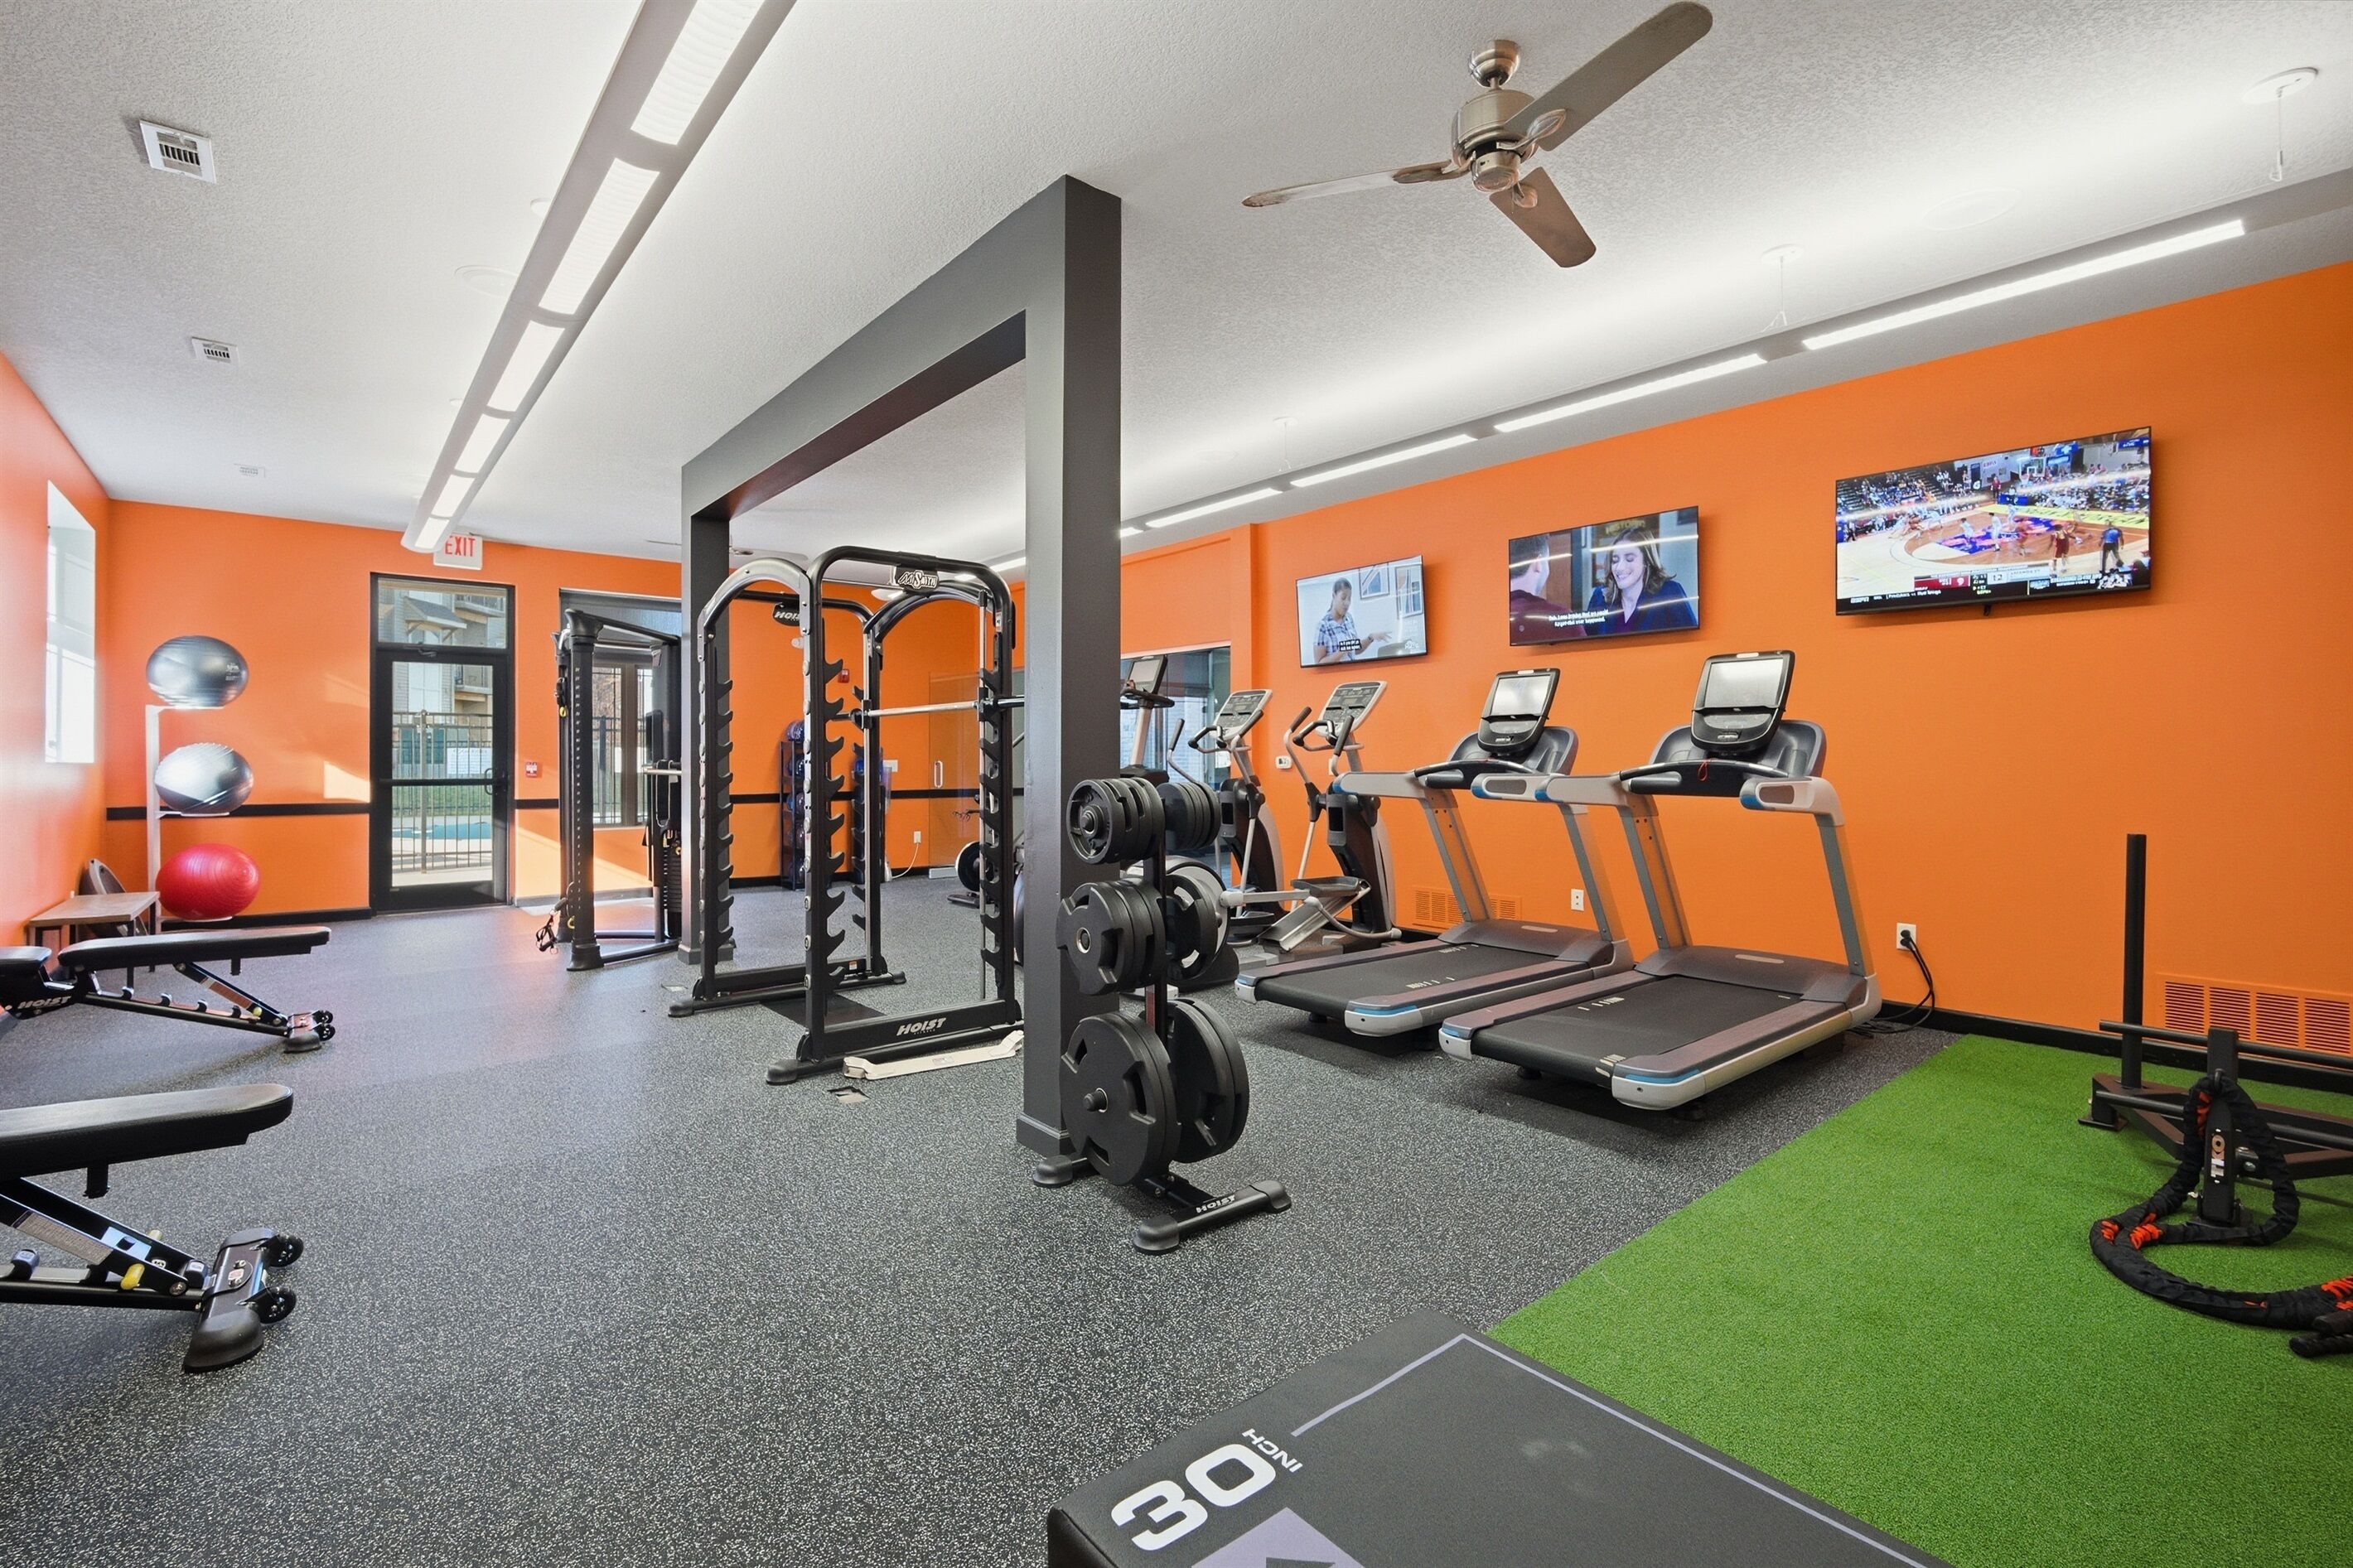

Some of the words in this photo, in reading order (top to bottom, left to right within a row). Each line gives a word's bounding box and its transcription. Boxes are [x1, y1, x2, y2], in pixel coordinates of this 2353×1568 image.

[444, 535, 476, 557] EXIT
[17, 996, 72, 1010] HOIST
[896, 1017, 947, 1036] HOIST
[1196, 1194, 1235, 1213] HOIST
[1242, 1428, 1303, 1473] INCH
[1111, 1444, 1276, 1551] 30
